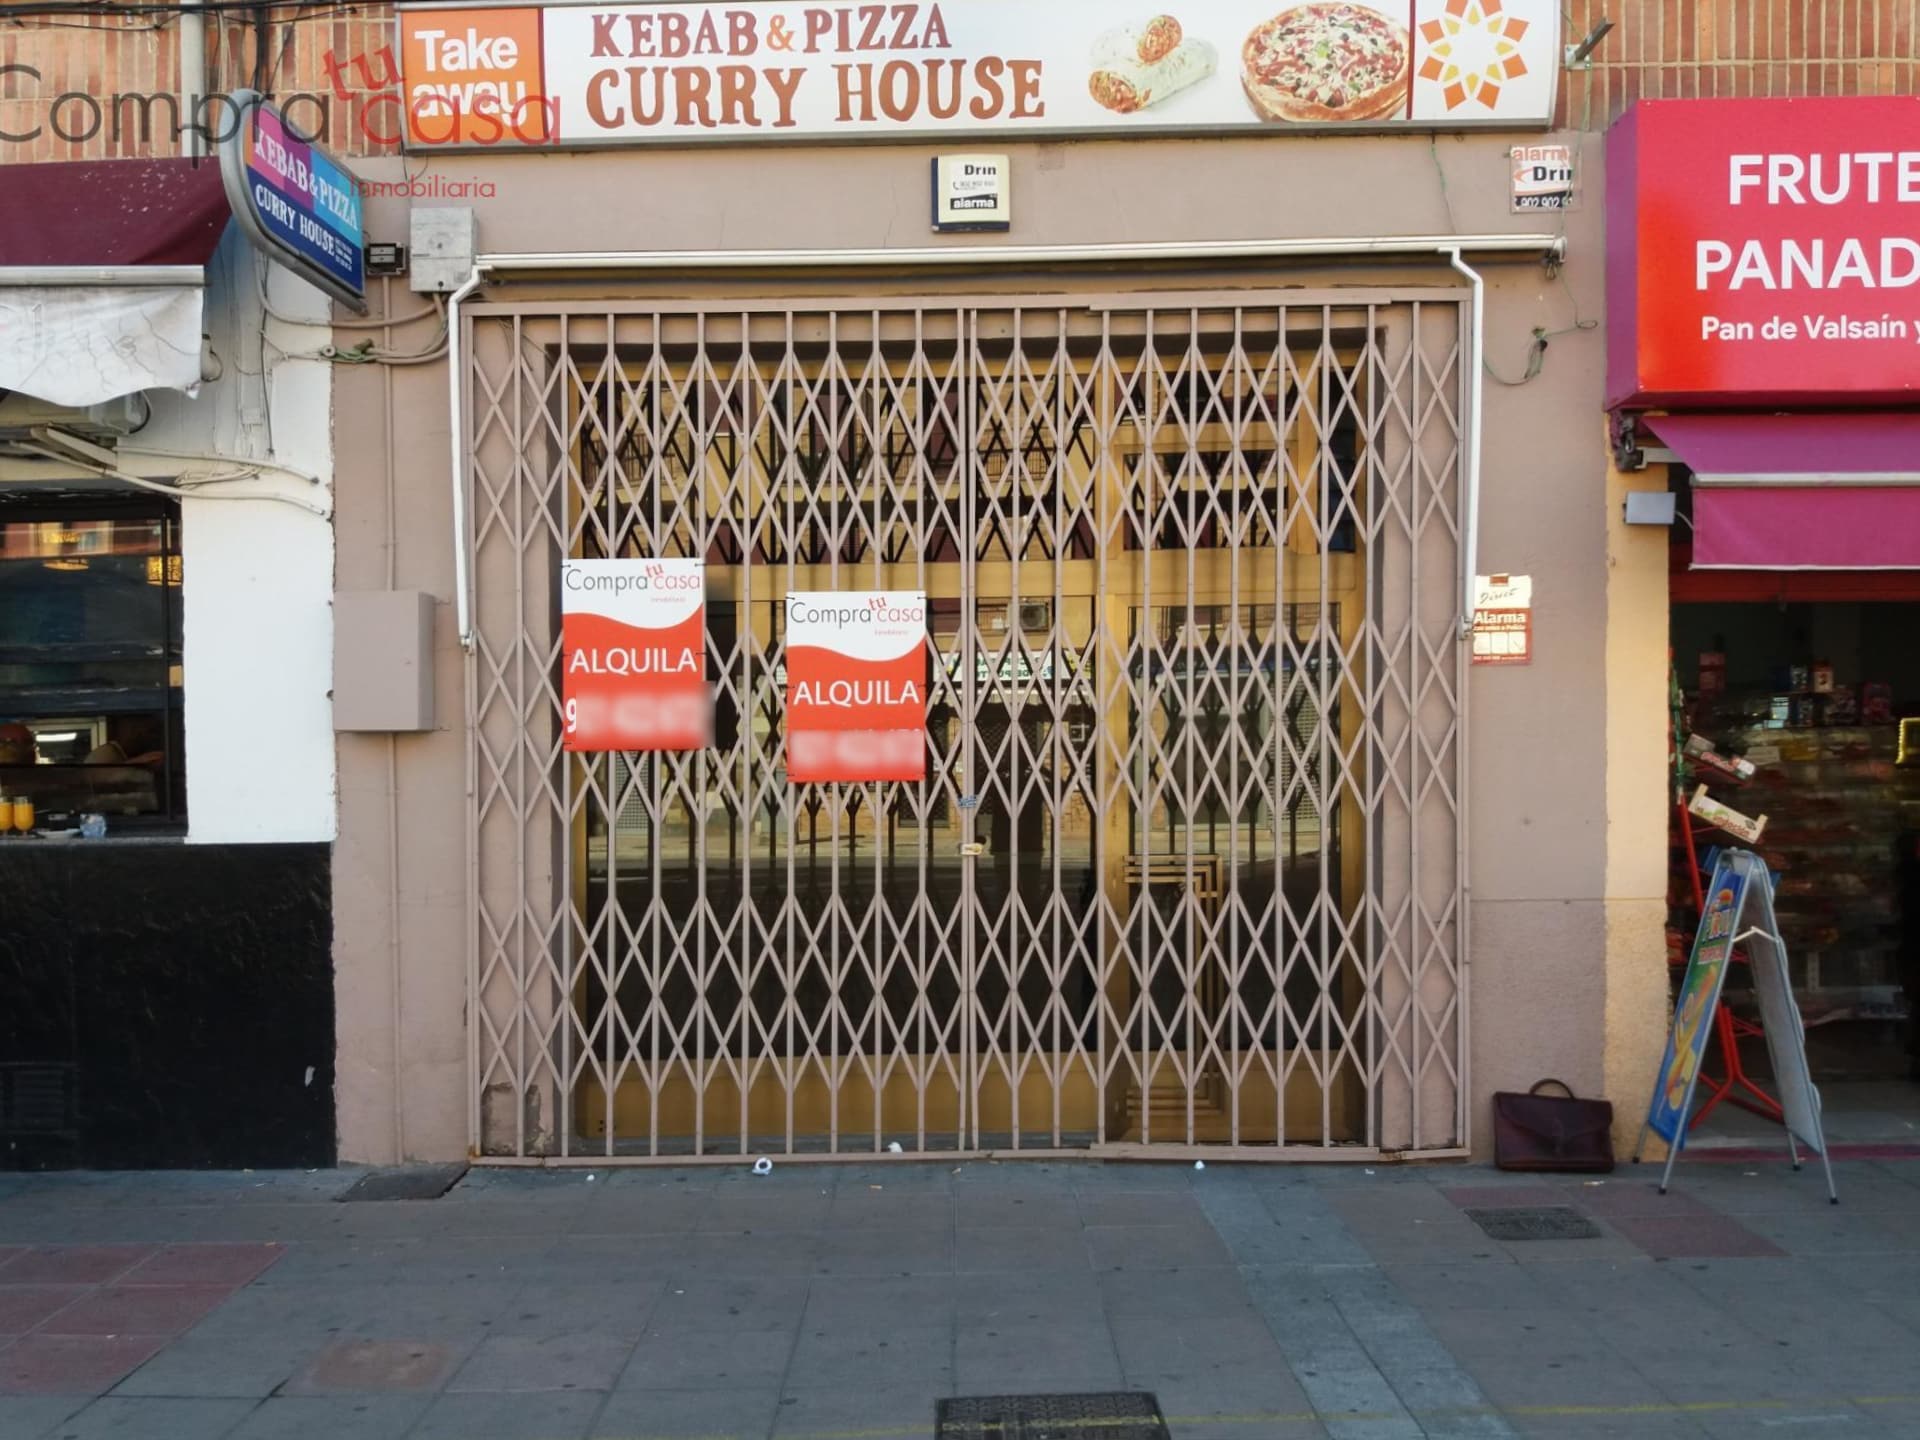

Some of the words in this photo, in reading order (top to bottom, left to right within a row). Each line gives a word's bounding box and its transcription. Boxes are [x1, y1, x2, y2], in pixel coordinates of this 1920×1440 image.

[414, 28, 519, 72] Take
[412, 81, 527, 127] away
[586, 64, 808, 129] CURRY
[831, 56, 1046, 122] HOUSE
[964, 164, 997, 176] Drin
[953, 198, 995, 209] alarma
[255, 184, 297, 231] CURRY
[300, 213, 336, 257] HOUSE
[1696, 238, 1920, 290] PANAD
[1702, 316, 1754, 341] Pan
[1761, 313, 1798, 341] de
[1803, 312, 1907, 340] Valsaín
[566, 568, 648, 597] Compra
[653, 575, 701, 590] casa
[645, 563, 664, 578] tu
[790, 601, 871, 629] Compra
[876, 607, 923, 622] casa
[868, 596, 887, 611] tu
[569, 647, 698, 675] ALQUILA
[793, 680, 920, 707] ALQUILA
